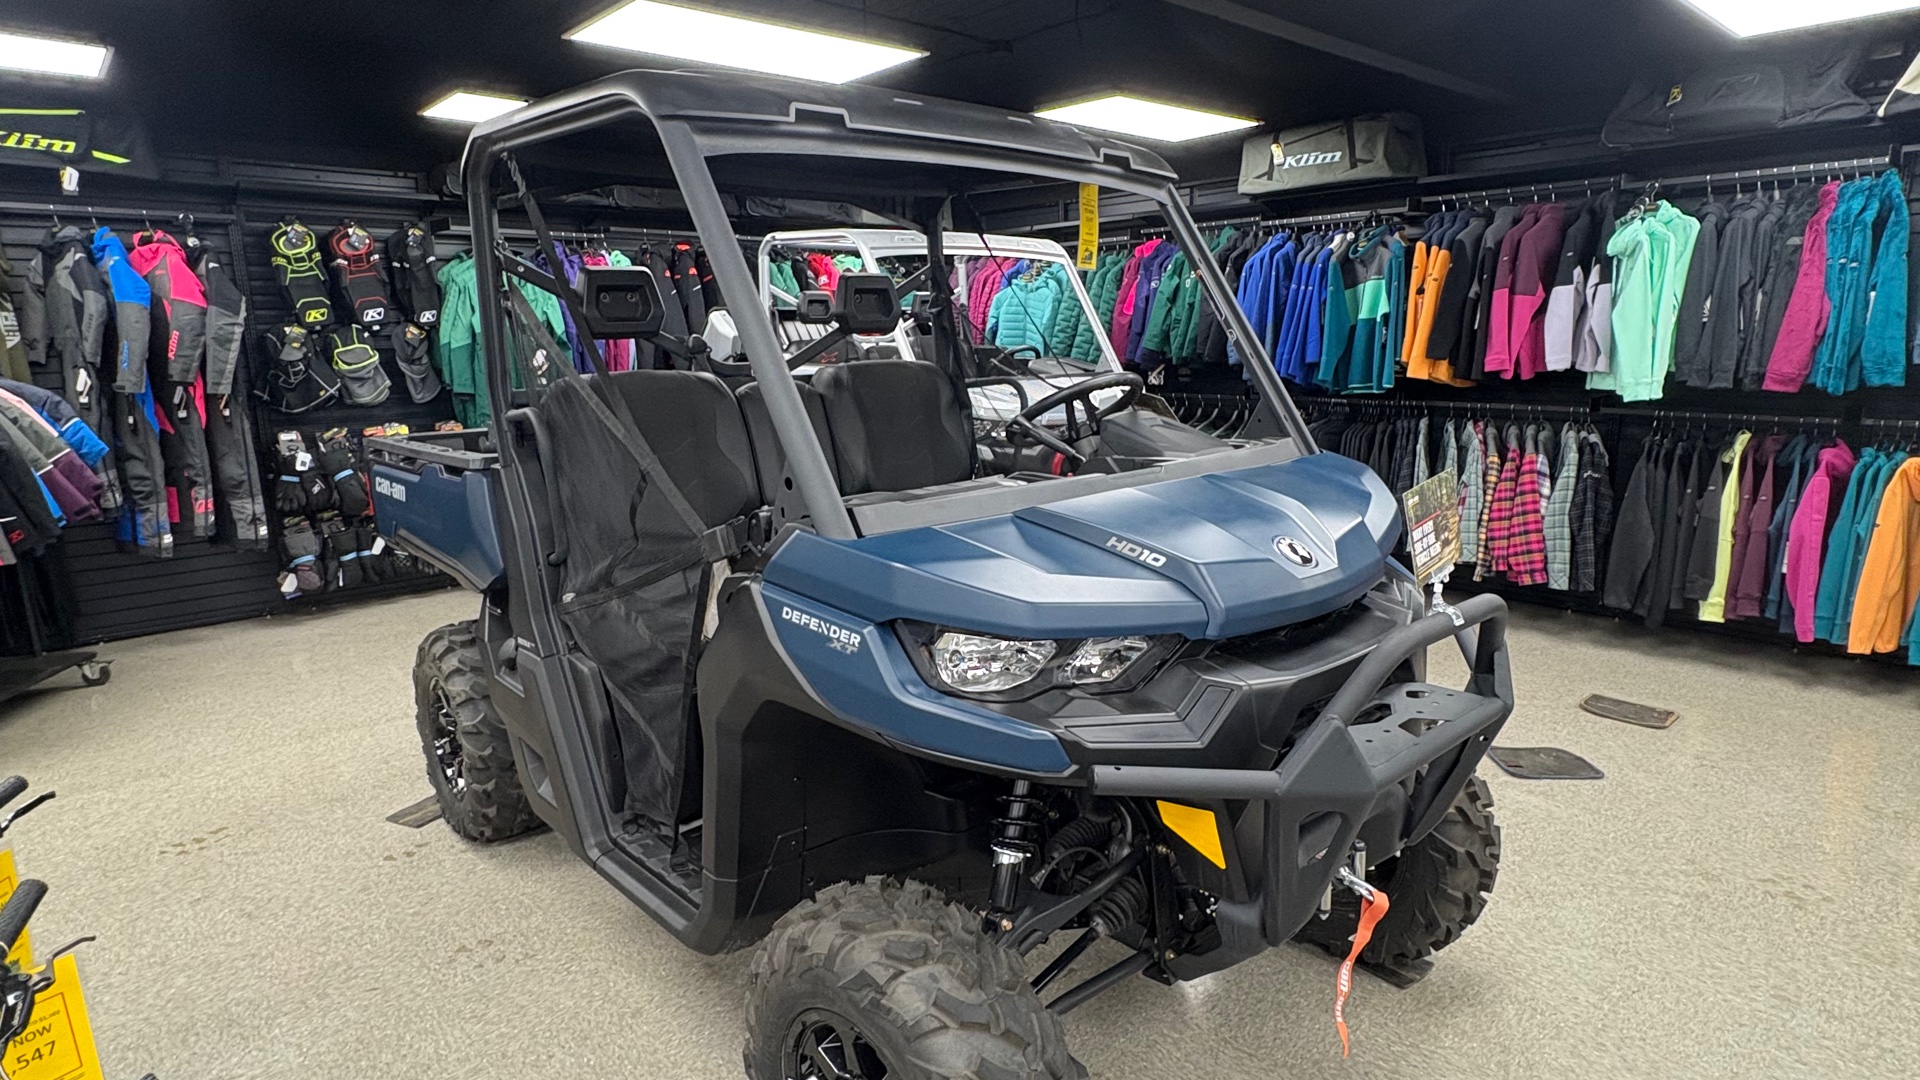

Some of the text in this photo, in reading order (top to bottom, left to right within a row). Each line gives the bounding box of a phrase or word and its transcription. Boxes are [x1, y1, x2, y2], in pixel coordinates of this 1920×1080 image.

[1282, 151, 1343, 170] Klim
[375, 476, 406, 503] can-am
[1105, 536, 1167, 568] HD10
[781, 606, 861, 648] DEFENDER
[826, 639, 858, 656] XT
[12, 1022, 52, 1049] NOW
[5, 1040, 56, 1078] ,547
